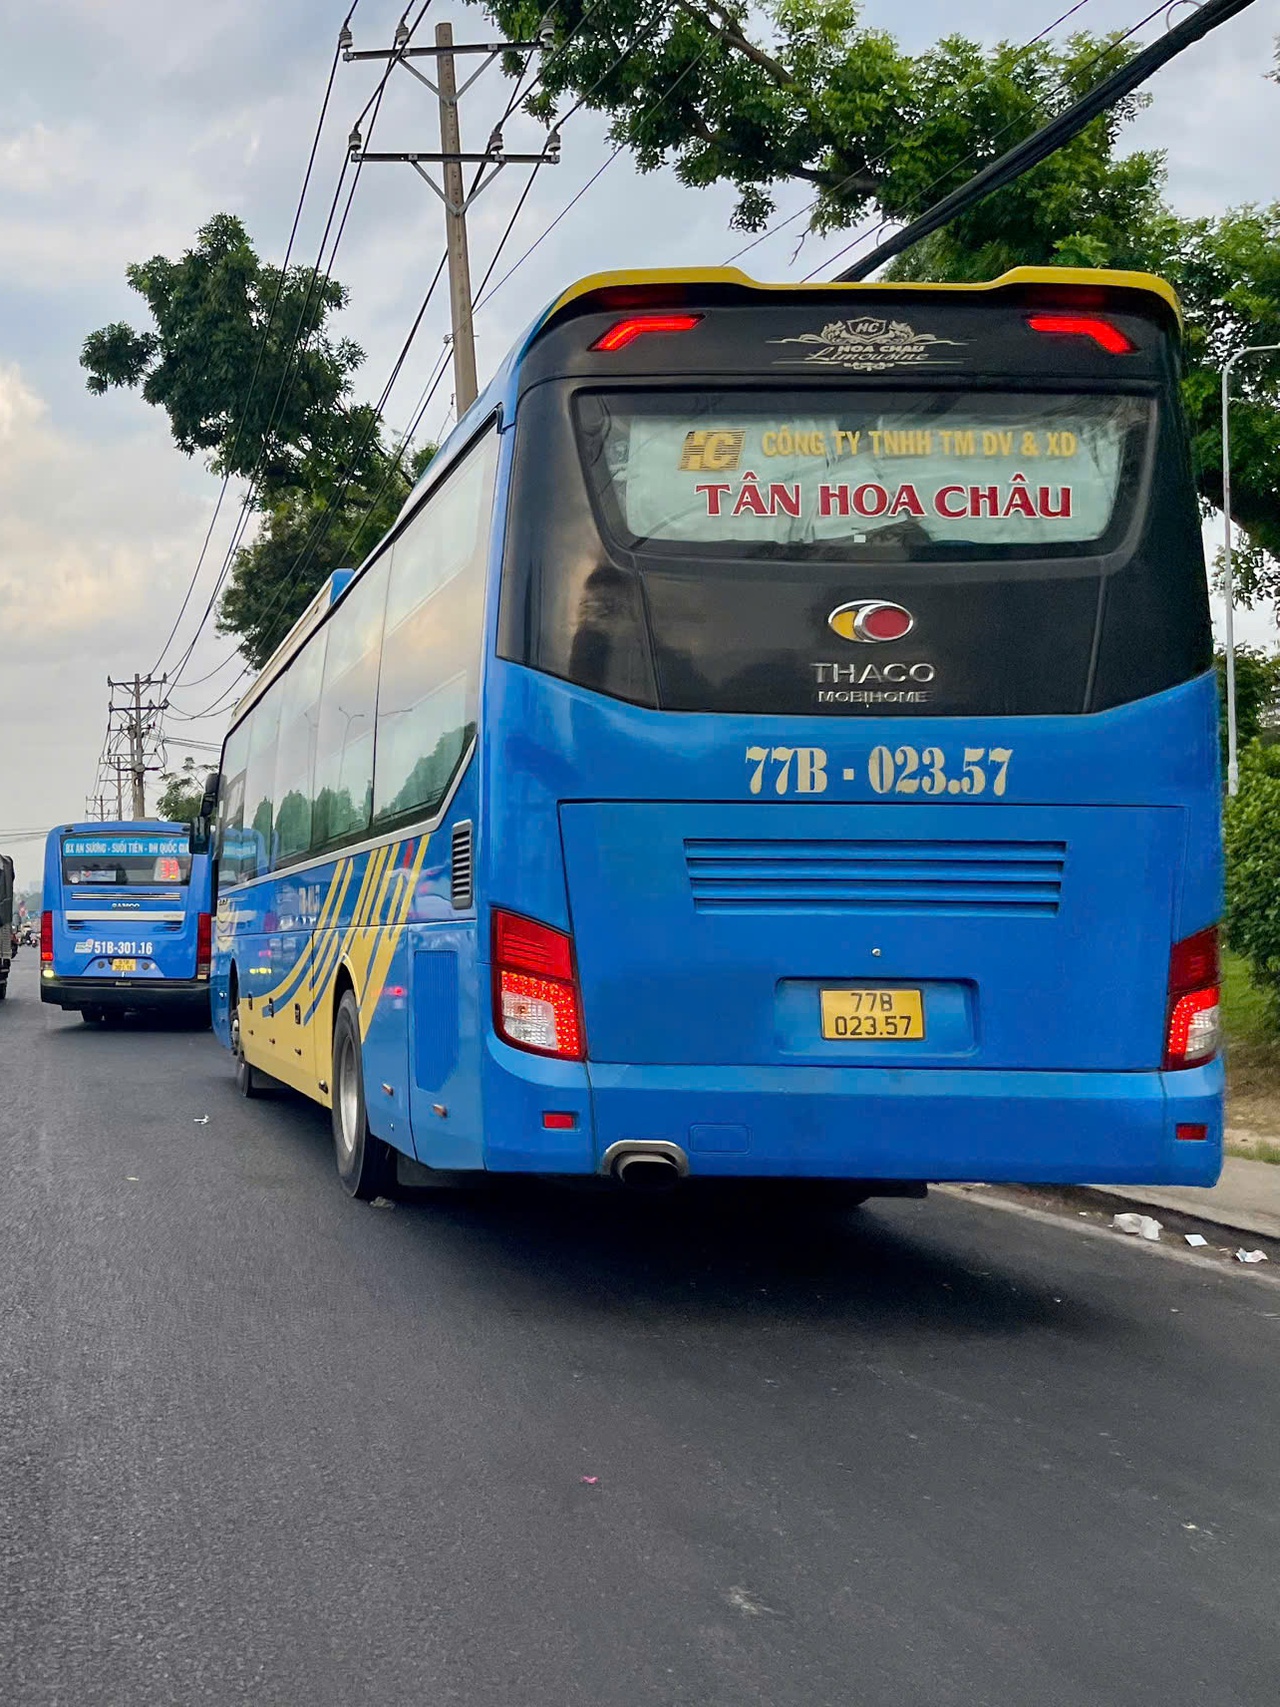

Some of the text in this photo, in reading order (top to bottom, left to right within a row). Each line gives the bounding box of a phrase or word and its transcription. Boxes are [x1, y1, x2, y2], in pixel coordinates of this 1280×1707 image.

[856, 322, 880, 333] HC
[804, 347, 930, 361] Limousine
[838, 345, 874, 353] HOA
[762, 425, 1078, 458] CÔNG TY TNHH TM DV & XD
[695, 471, 1073, 519] TÂN HOA CHÂU
[811, 663, 935, 684] THACO
[818, 691, 931, 703] MOBIHOME
[745, 746, 827, 795] 77B
[868, 746, 1014, 796] 023.57
[75, 843, 84, 853] AN
[94, 941, 153, 954] 51B-301.16
[850, 993, 893, 1013] 77B
[834, 1015, 912, 1036] 023.57
